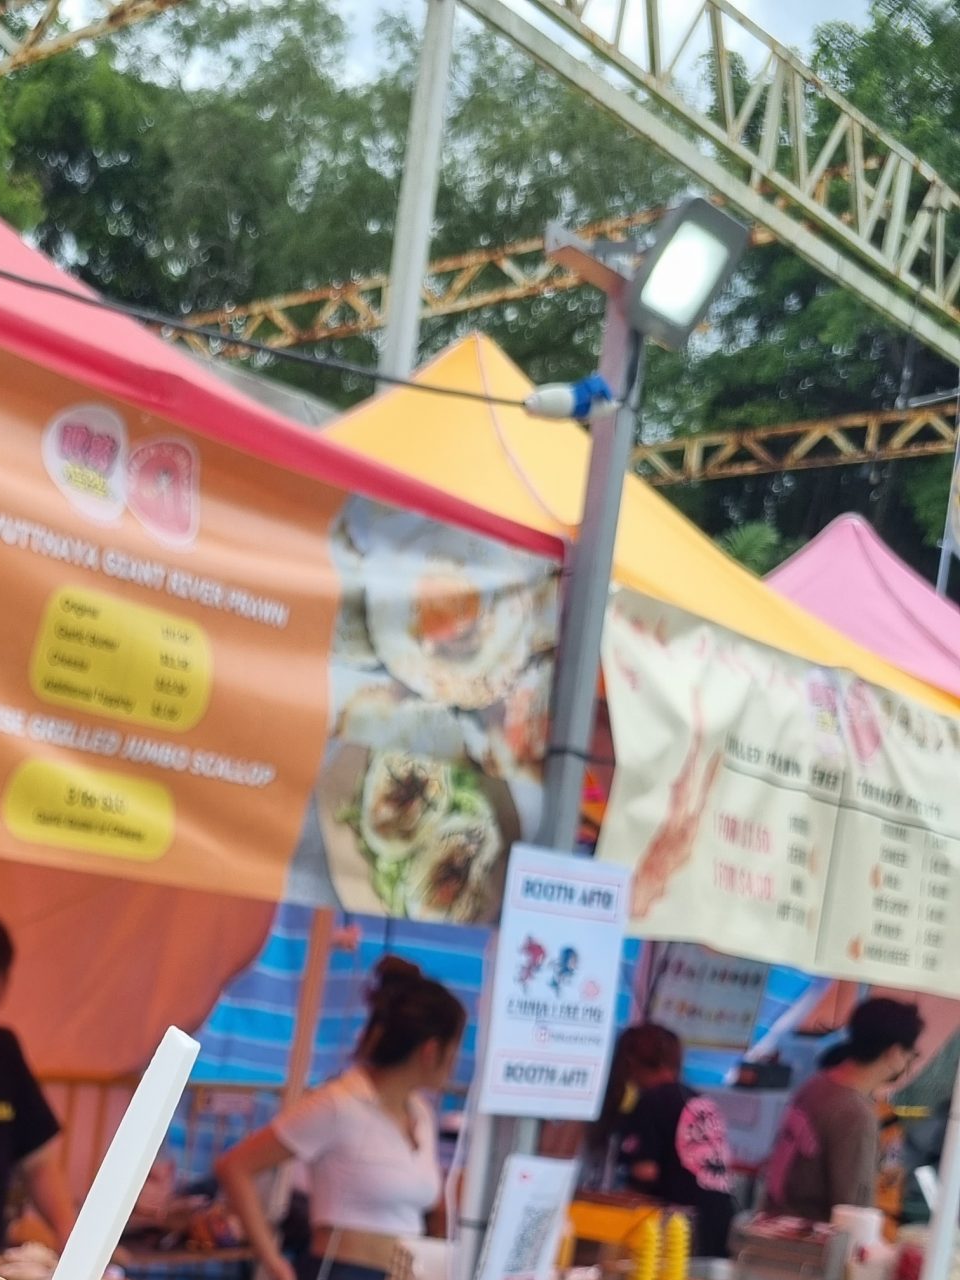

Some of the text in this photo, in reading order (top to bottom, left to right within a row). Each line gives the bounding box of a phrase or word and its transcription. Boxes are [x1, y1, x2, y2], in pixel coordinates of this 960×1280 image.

[123, 737, 188, 769] JUMBO
[522, 878, 574, 902] BOOTH
[503, 1063, 555, 1086] BOOTH
